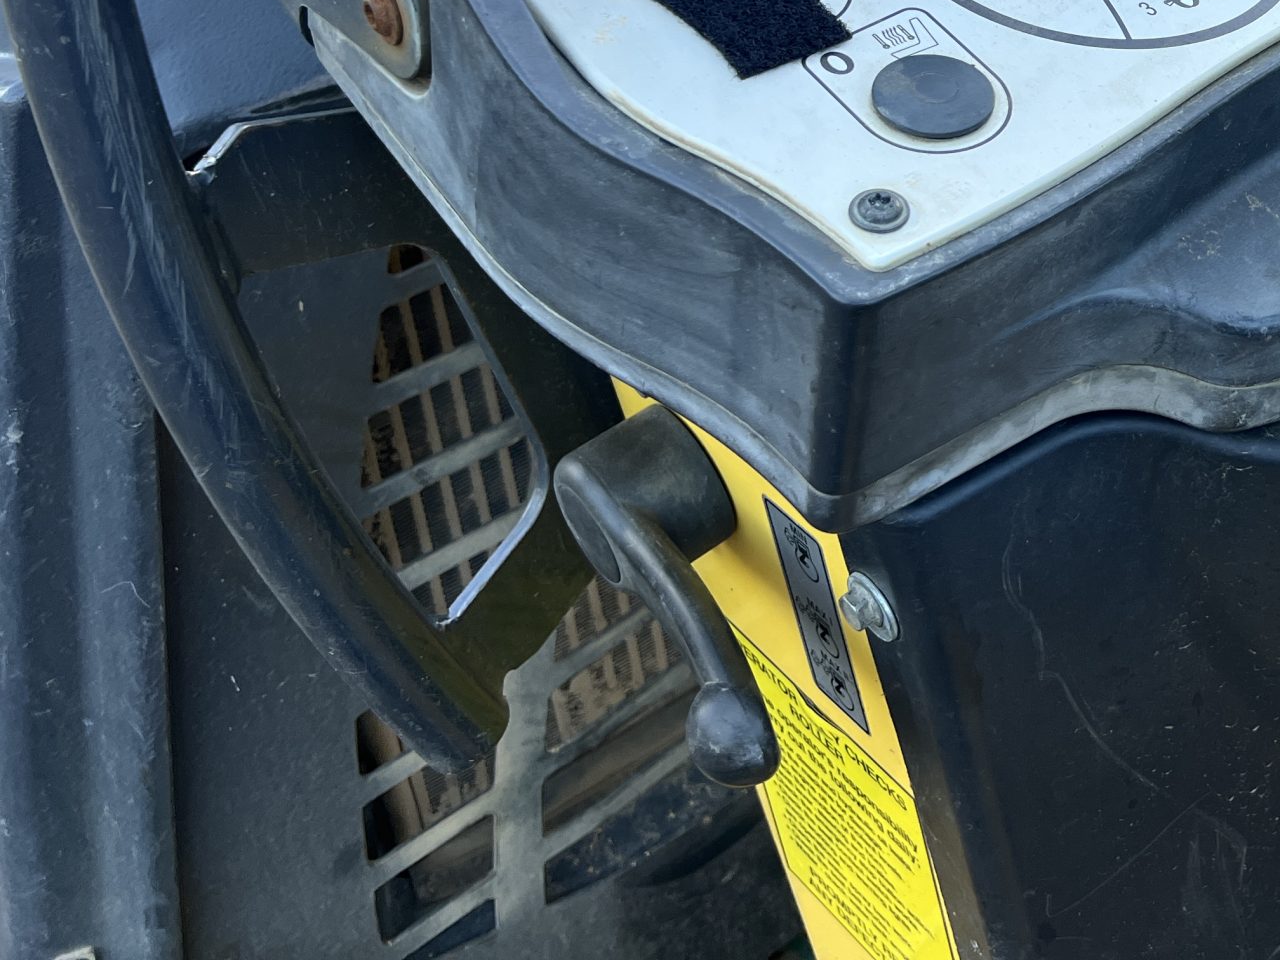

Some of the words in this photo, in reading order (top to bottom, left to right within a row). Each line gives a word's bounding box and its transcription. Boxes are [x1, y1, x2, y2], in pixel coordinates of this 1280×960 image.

[1138, 1, 1158, 16] 3
[742, 644, 799, 706] ERATOR
[844, 744, 908, 812] CHECKS
[788, 702, 846, 767] ROLLER
